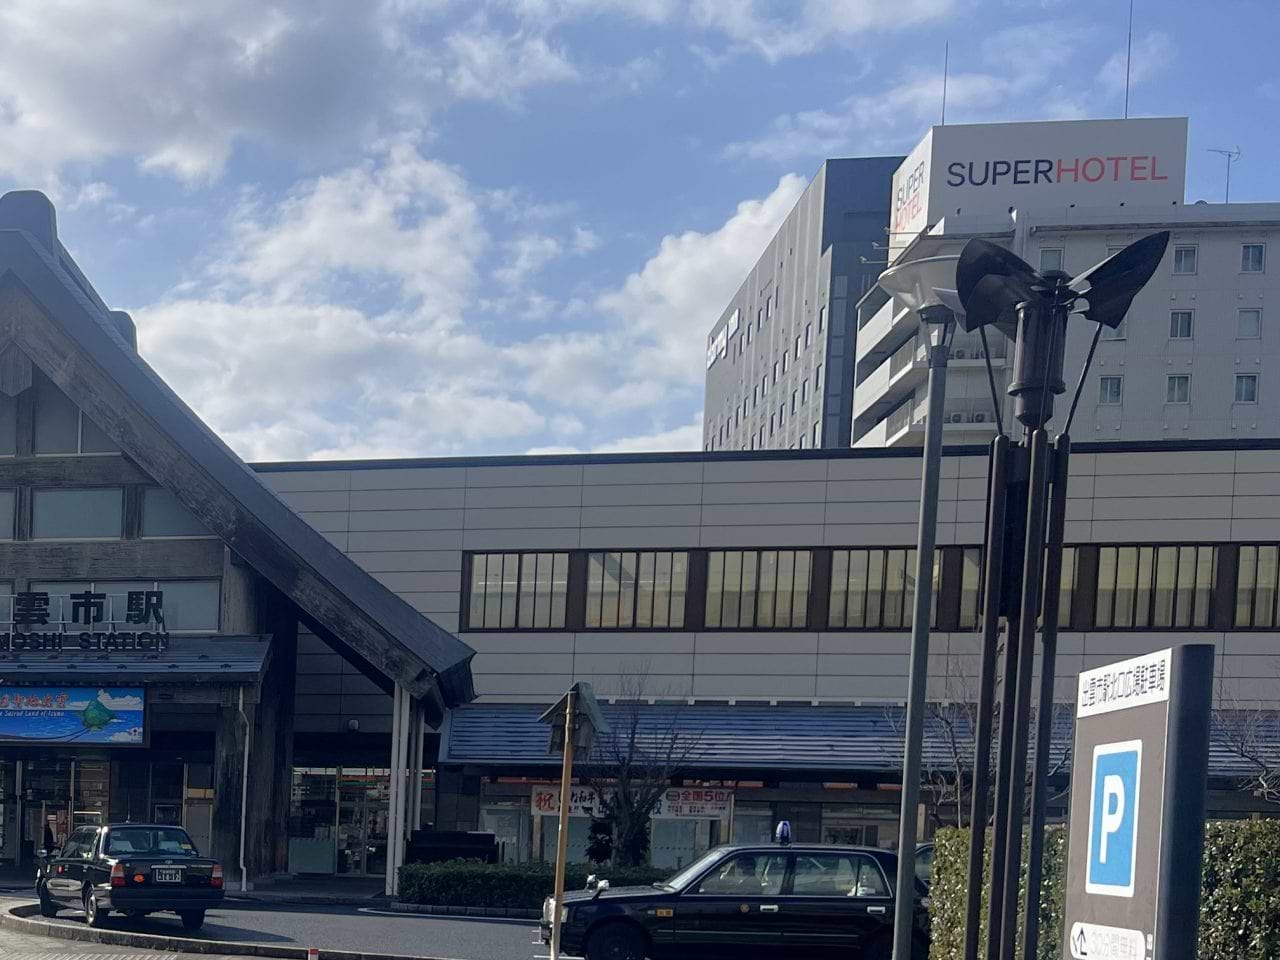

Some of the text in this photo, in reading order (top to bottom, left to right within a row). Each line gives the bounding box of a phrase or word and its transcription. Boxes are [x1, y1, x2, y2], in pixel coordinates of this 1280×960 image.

[897, 161, 925, 212] SUPER
[946, 156, 1169, 187] SUPERHOTEL
[895, 193, 922, 234] HOTEL
[78, 632, 170, 650] STATION
[1082, 659, 1166, 707] 出雲市駅北口広場駐車場
[1099, 774, 1125, 864] P
